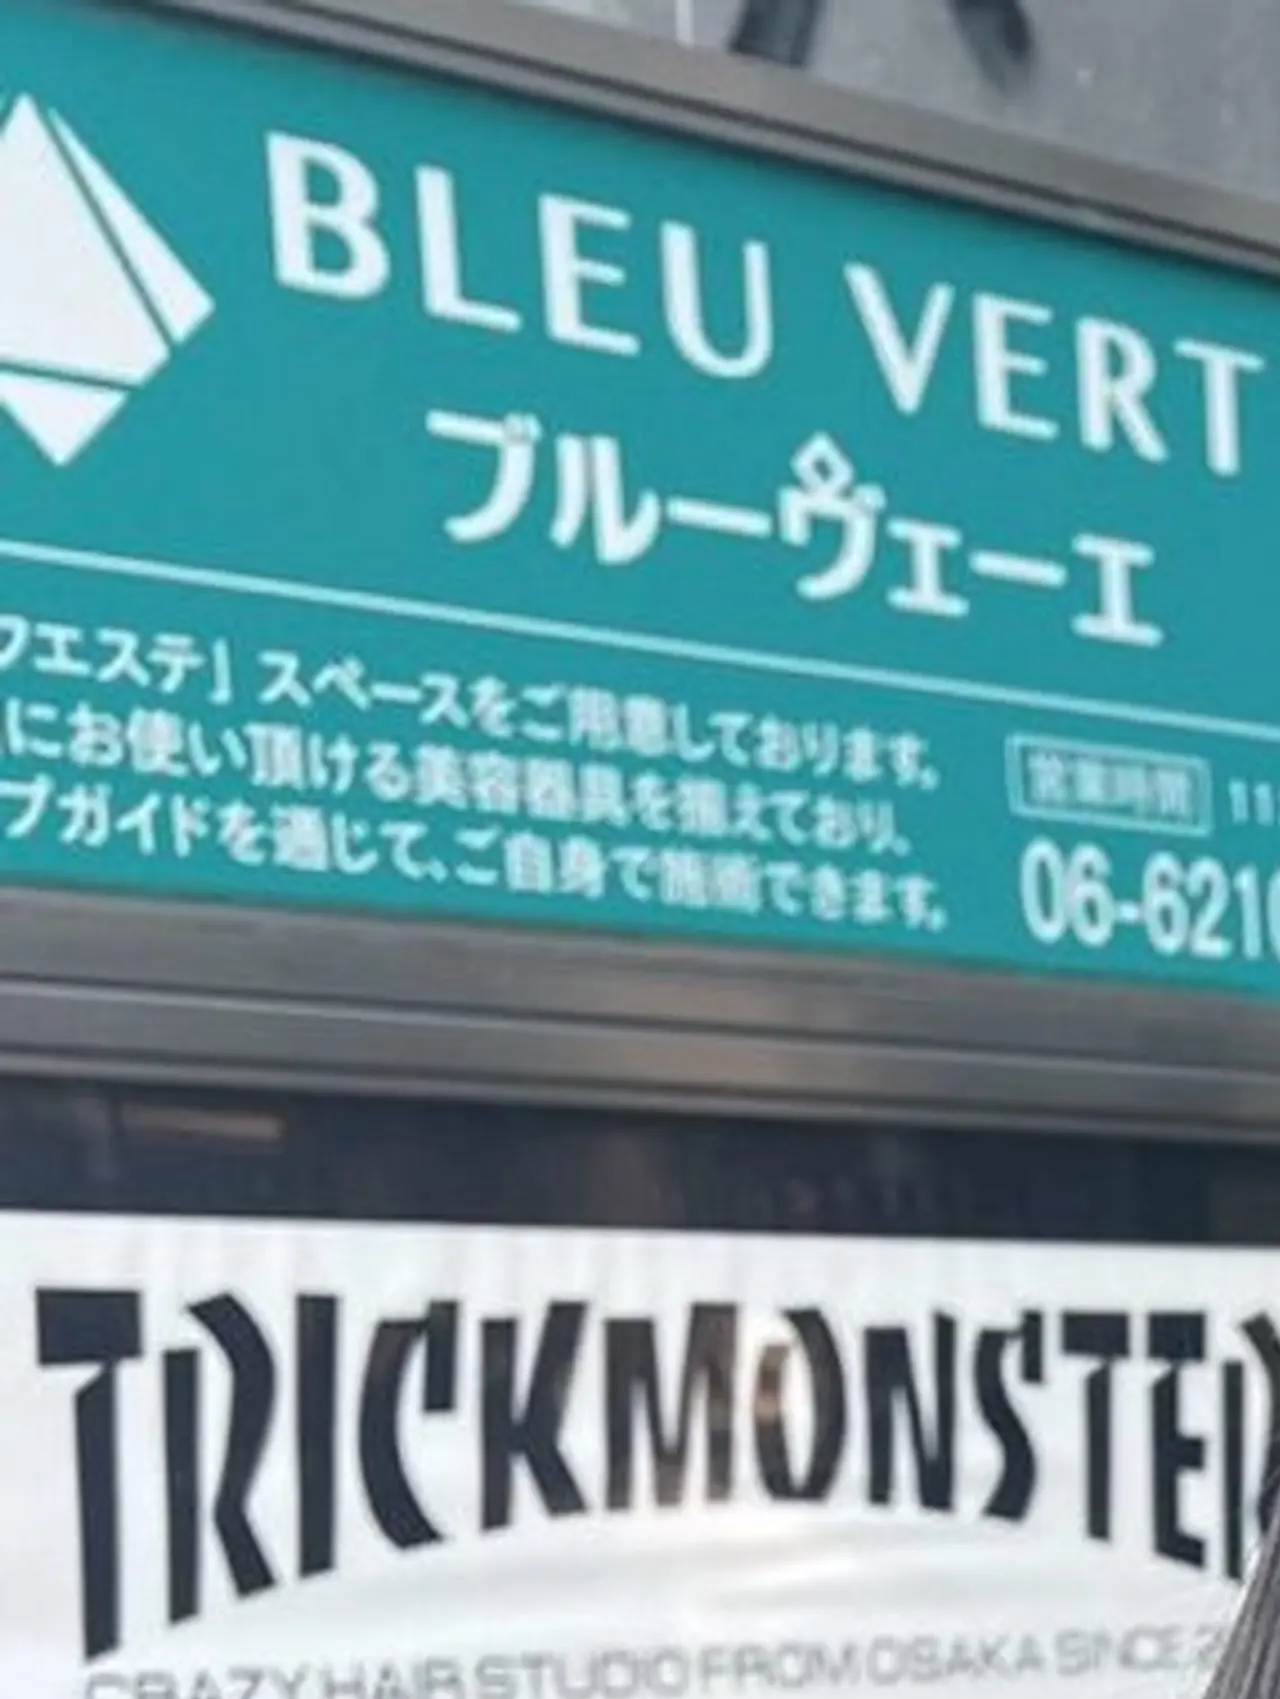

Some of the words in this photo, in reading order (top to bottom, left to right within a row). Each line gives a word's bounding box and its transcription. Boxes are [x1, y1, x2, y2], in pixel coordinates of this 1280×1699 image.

[265, 131, 774, 378] BLEU
[843, 262, 1266, 478] VERT
[425, 410, 1164, 647] ブルーヴェーエ
[697, 1641, 862, 1699] FROM
[864, 1632, 1049, 1690] OSAKA
